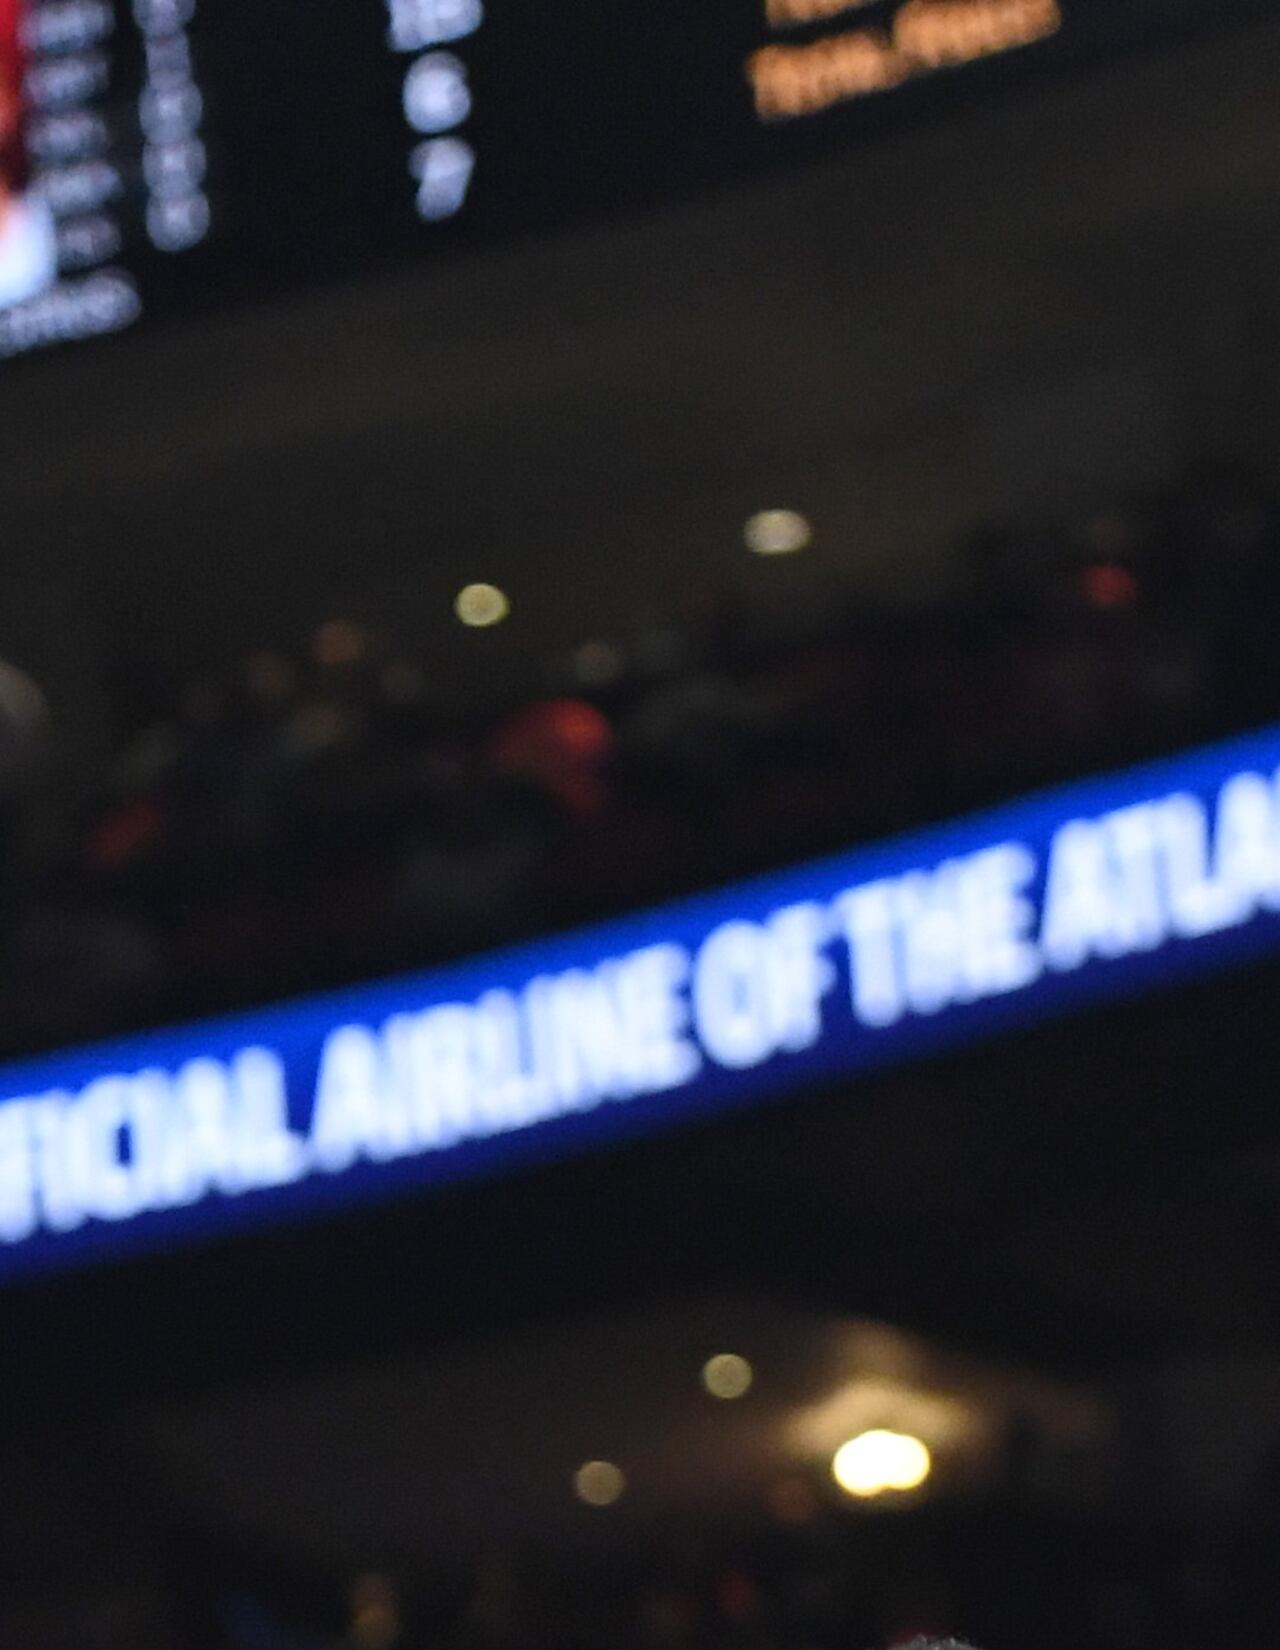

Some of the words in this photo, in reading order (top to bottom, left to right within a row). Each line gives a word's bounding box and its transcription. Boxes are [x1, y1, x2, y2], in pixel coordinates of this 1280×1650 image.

[311, 942, 698, 1173] AIRLINE
[696, 900, 836, 1069] OF
[833, 841, 1044, 1028] THE
